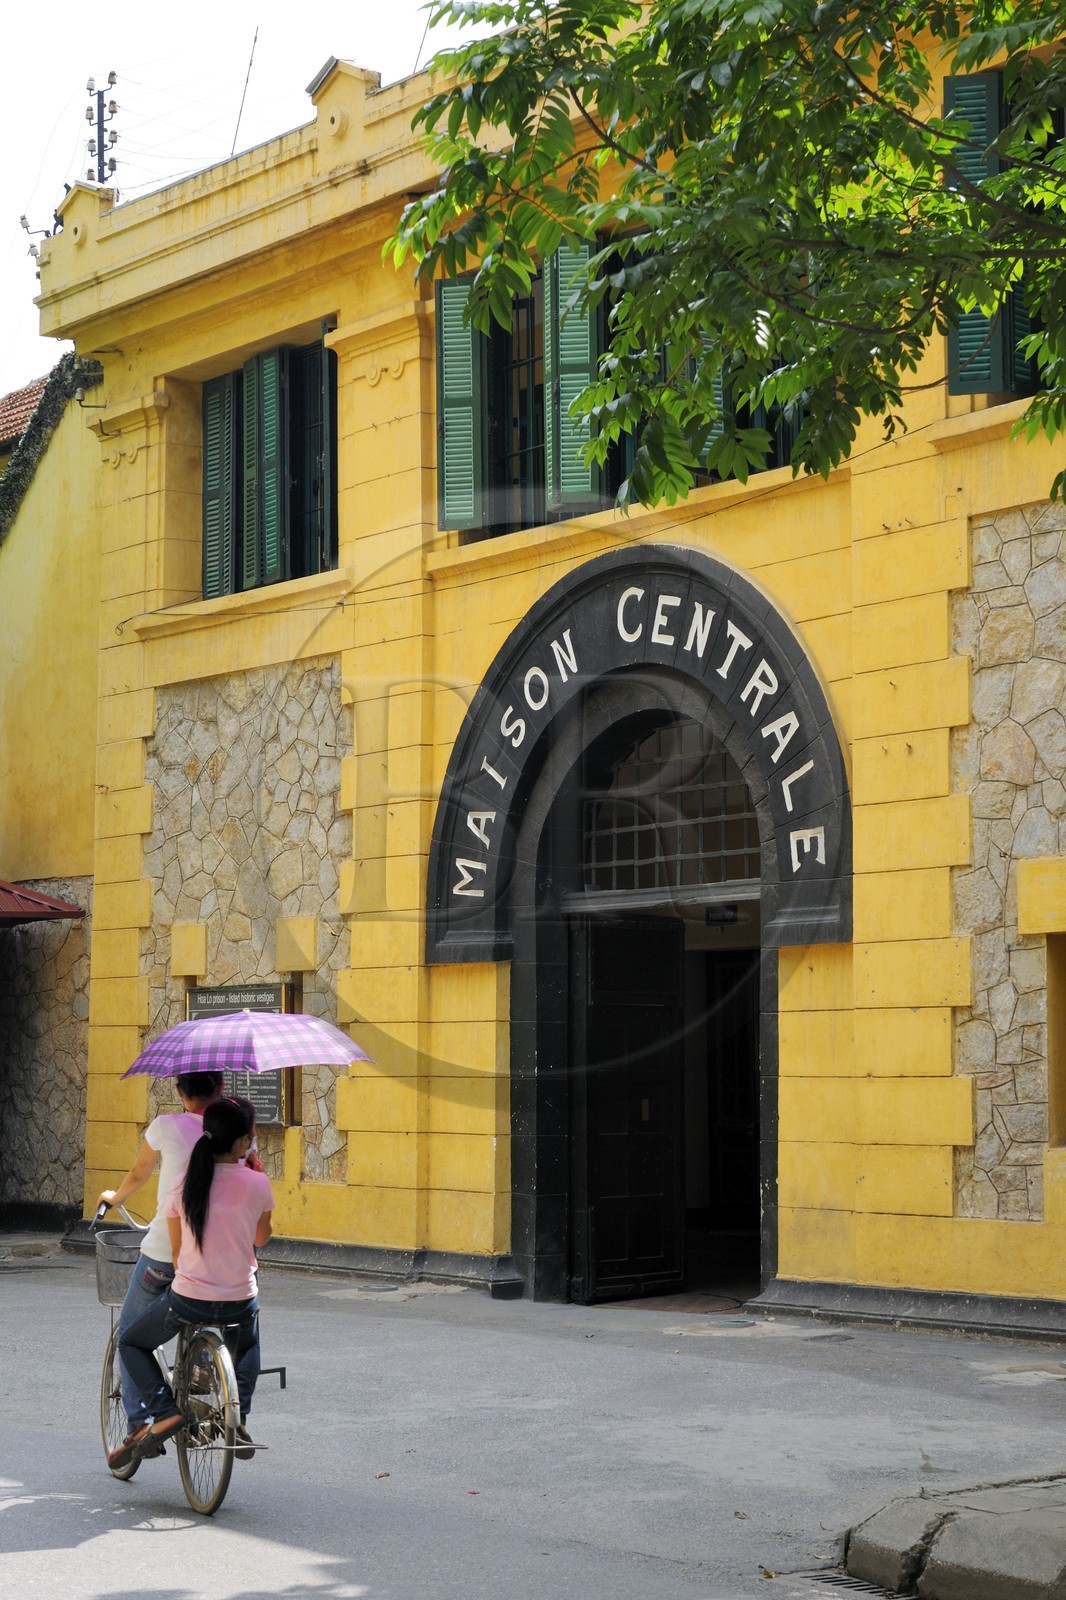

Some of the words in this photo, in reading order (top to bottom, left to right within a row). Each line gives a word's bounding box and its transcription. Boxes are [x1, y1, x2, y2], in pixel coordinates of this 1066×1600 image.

[452, 628, 579, 898] MAISON
[616, 586, 826, 873] CENTRALE
[197, 995, 206, 1004] Hoa
[206, 993, 213, 1004] Lo
[213, 993, 226, 1006] prison
[229, 992, 240, 1003] listed
[241, 992, 256, 1003] historic
[256, 991, 275, 1005] vestiges
